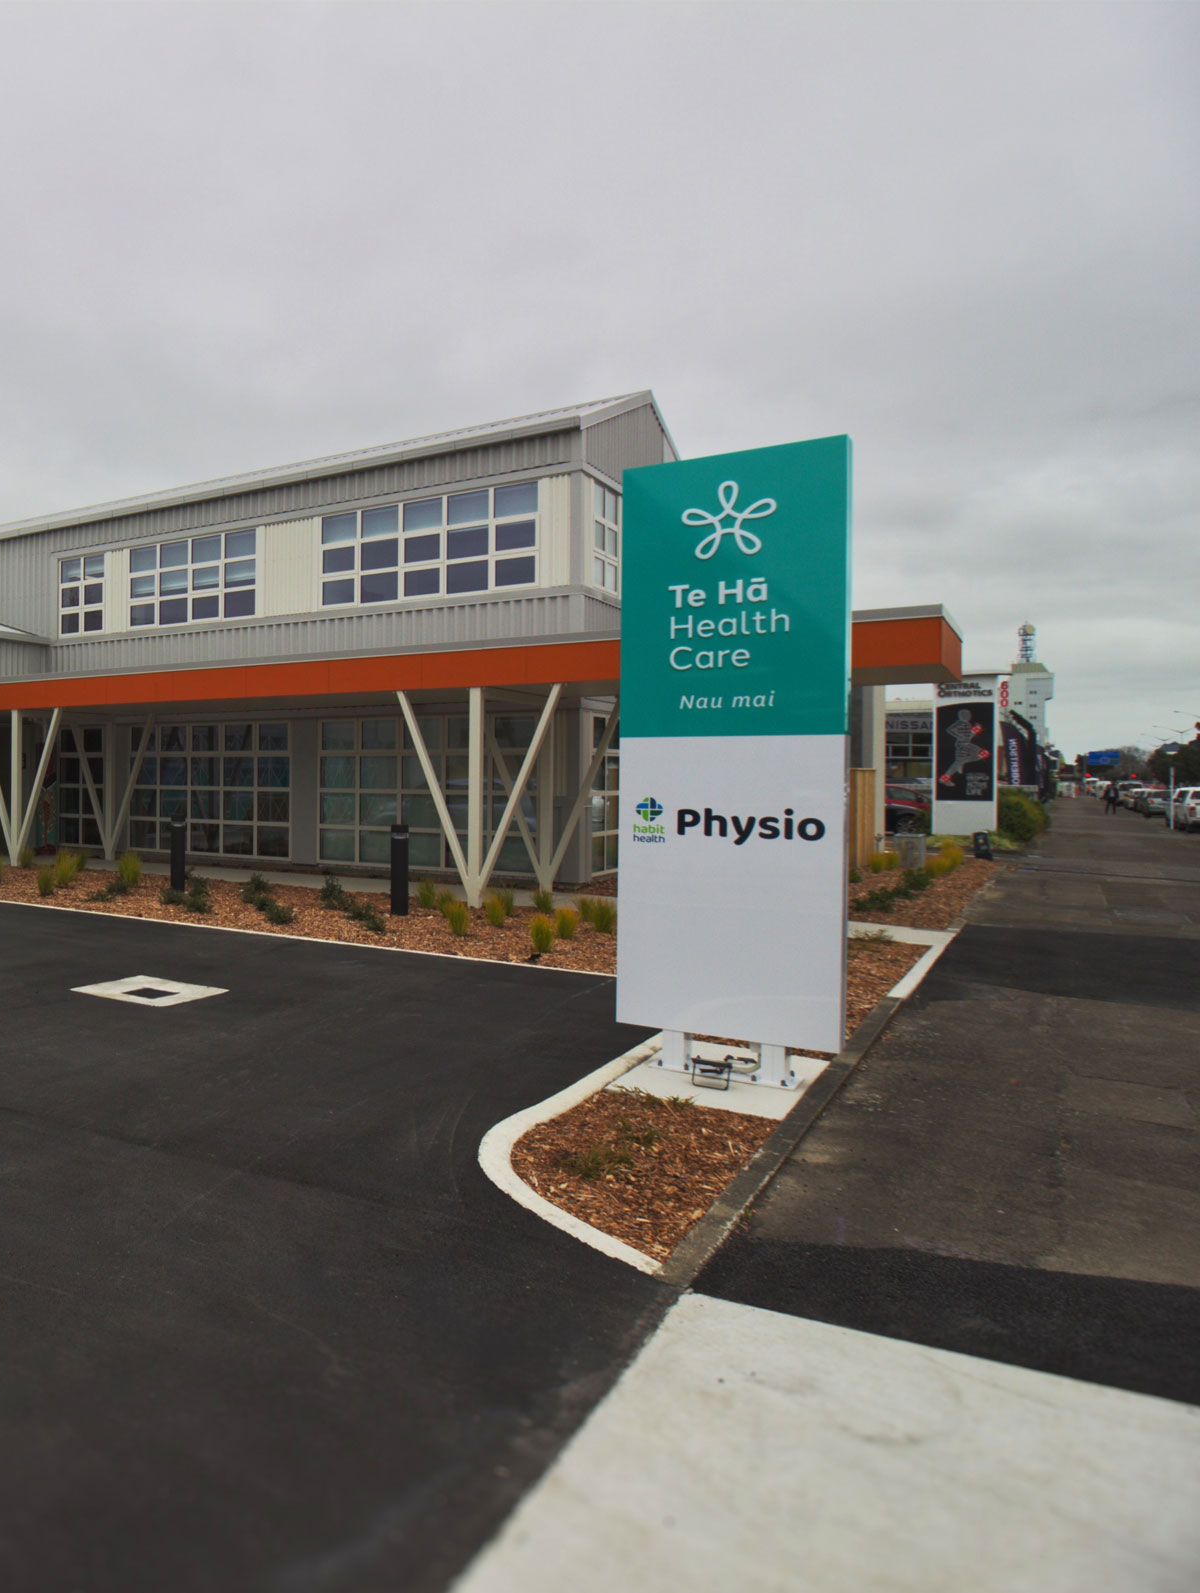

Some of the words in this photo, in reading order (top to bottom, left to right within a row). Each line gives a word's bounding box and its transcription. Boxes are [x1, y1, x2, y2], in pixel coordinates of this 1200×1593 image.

[668, 584, 707, 608] Te
[718, 577, 768, 605] Hā
[670, 608, 790, 639] Health
[669, 646, 751, 670] Care
[938, 681, 982, 690] CENTRAL
[938, 689, 993, 698] ORTHOTICS
[1000, 680, 1009, 708] 600
[680, 695, 723, 709] Nau
[731, 690, 775, 708] mai
[886, 720, 932, 730] NISSA
[633, 823, 665, 834] habit
[677, 808, 826, 846] Physio
[633, 834, 666, 843] health
